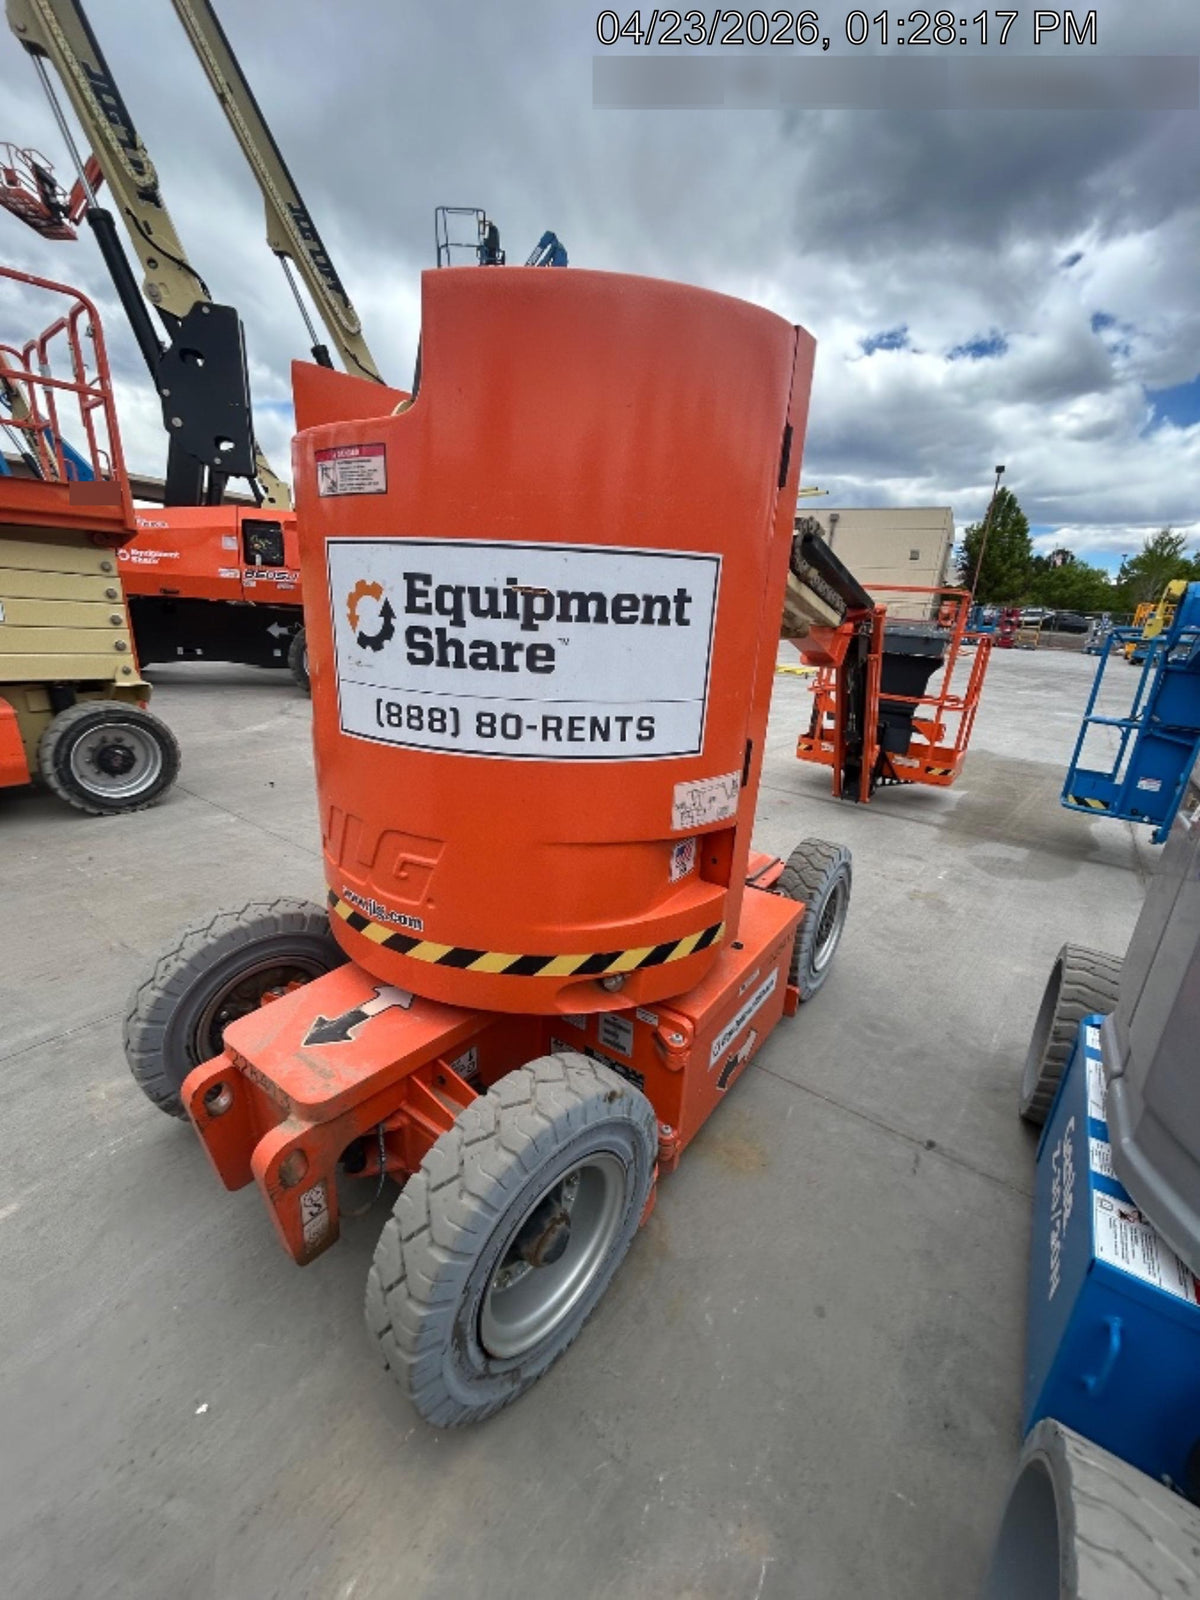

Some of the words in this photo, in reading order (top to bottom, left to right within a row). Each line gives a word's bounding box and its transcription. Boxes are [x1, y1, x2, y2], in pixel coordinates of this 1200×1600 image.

[403, 572, 692, 631] Equipment
[404, 625, 556, 674] Share
[376, 698, 460, 738] (888)
[475, 710, 656, 743] 80-RENTS
